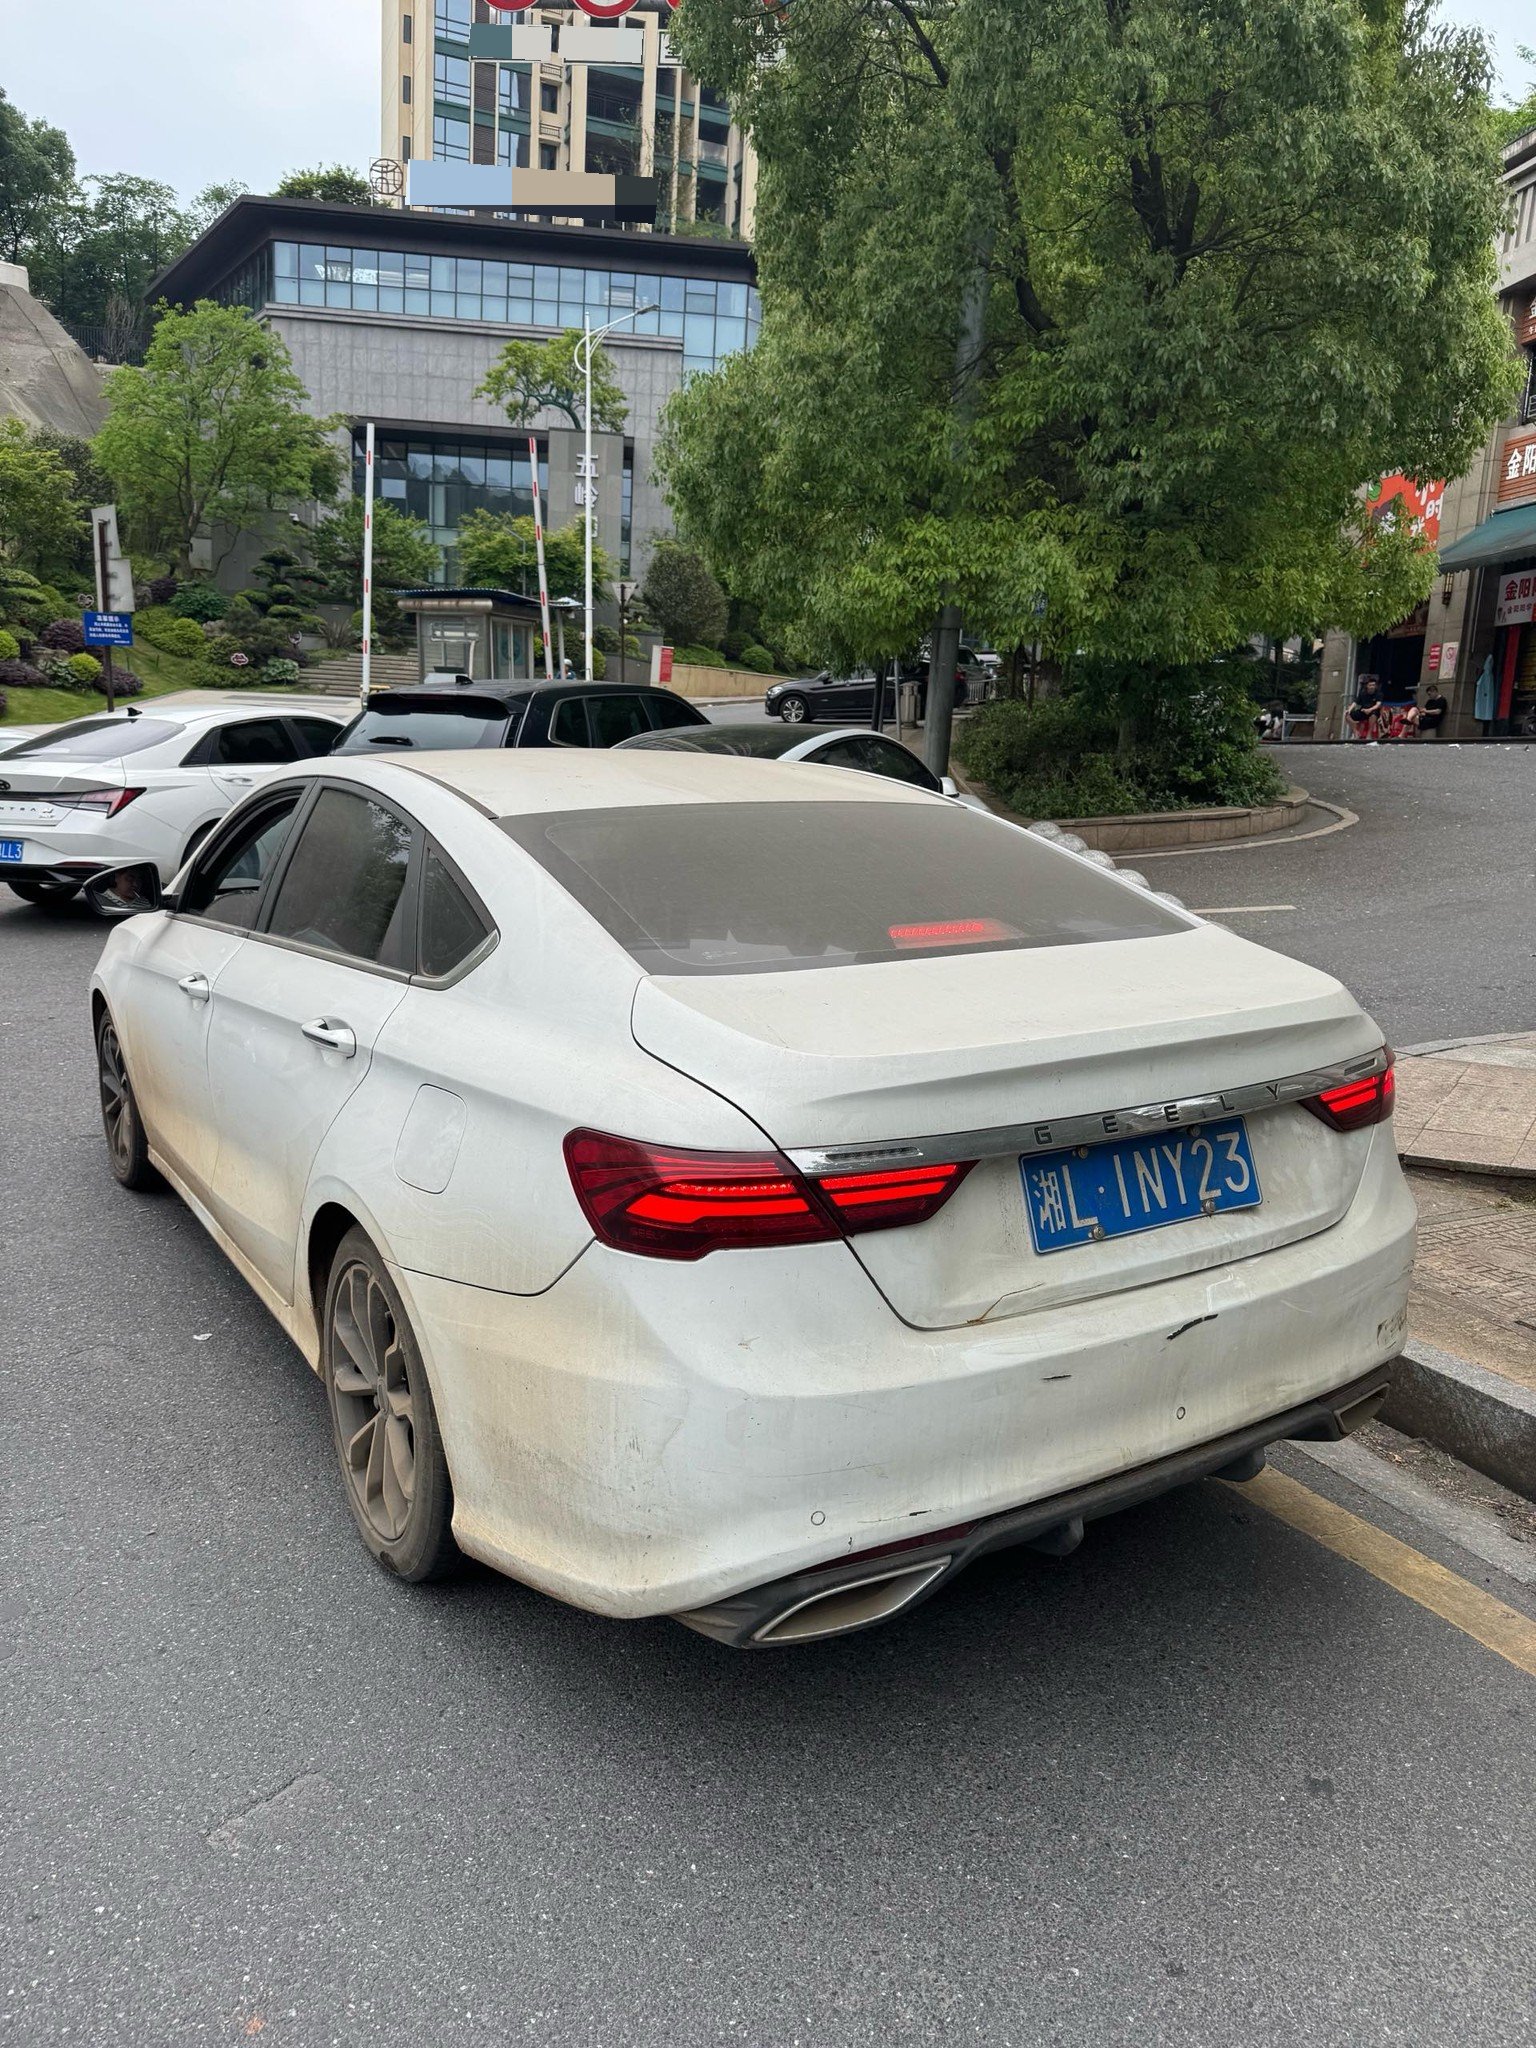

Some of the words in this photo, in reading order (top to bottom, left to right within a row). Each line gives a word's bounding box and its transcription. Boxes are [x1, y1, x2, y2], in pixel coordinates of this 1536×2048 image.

[1505, 577, 1536, 601] 金阳
[0, 843, 22, 859] LL3
[1034, 1083, 1281, 1145] GEELY
